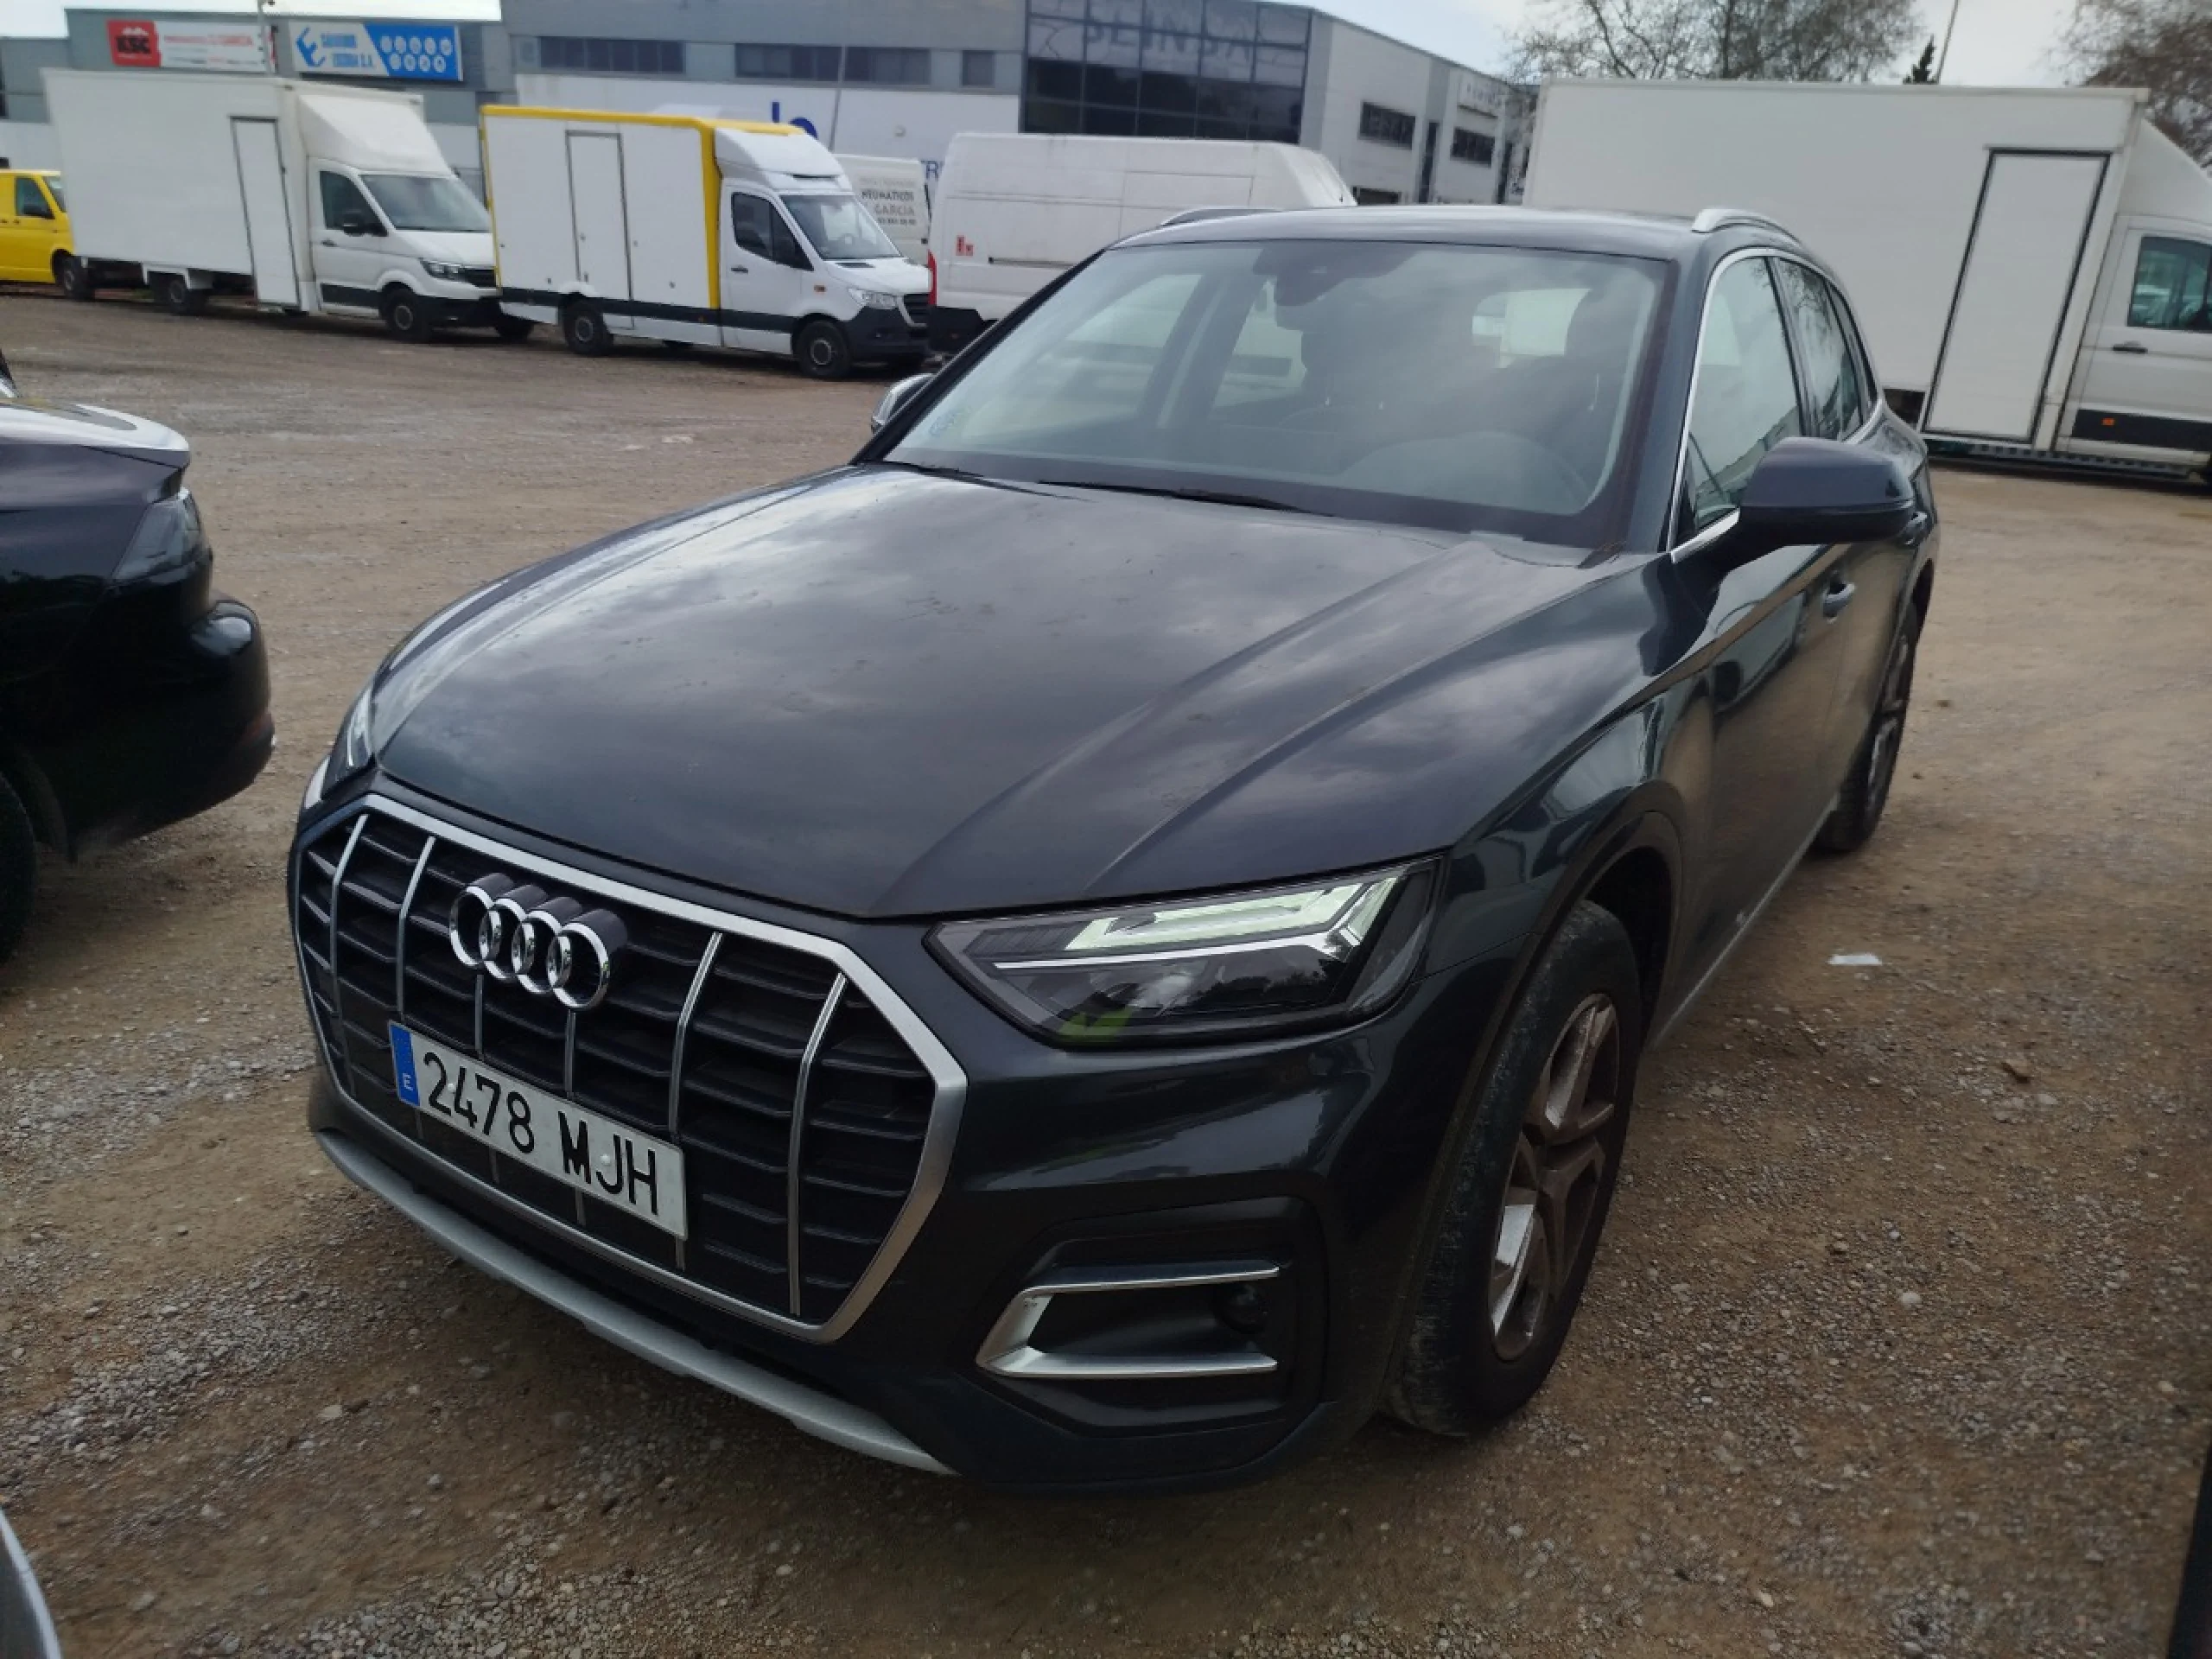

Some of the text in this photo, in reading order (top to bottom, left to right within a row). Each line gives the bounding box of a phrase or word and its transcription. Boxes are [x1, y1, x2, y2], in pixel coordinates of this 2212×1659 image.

[403, 1071, 413, 1091] E
[423, 1051, 659, 1216] 2478 MJH
